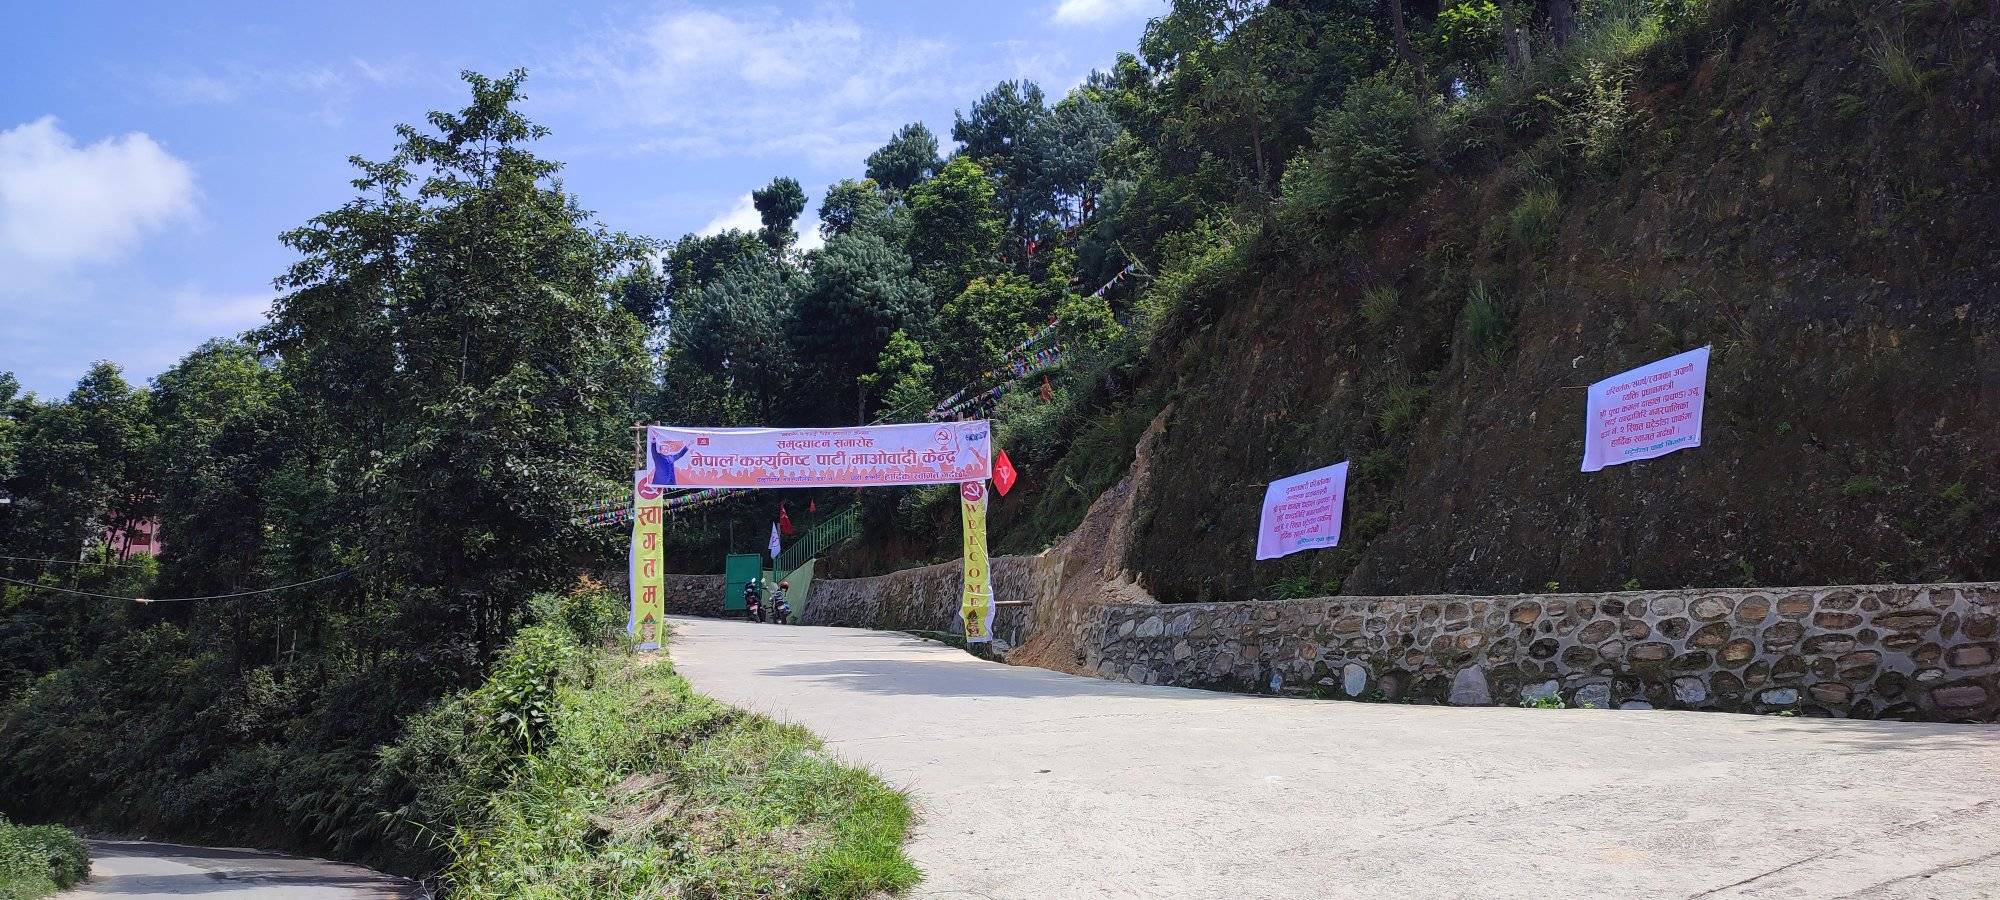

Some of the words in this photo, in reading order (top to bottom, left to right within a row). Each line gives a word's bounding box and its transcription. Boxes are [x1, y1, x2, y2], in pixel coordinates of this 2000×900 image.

[691, 452, 735, 467] नेपाल
[851, 450, 917, 465] माओवादी
[922, 449, 956, 463] केन्द्र
[966, 503, 981, 607] WELCOME
